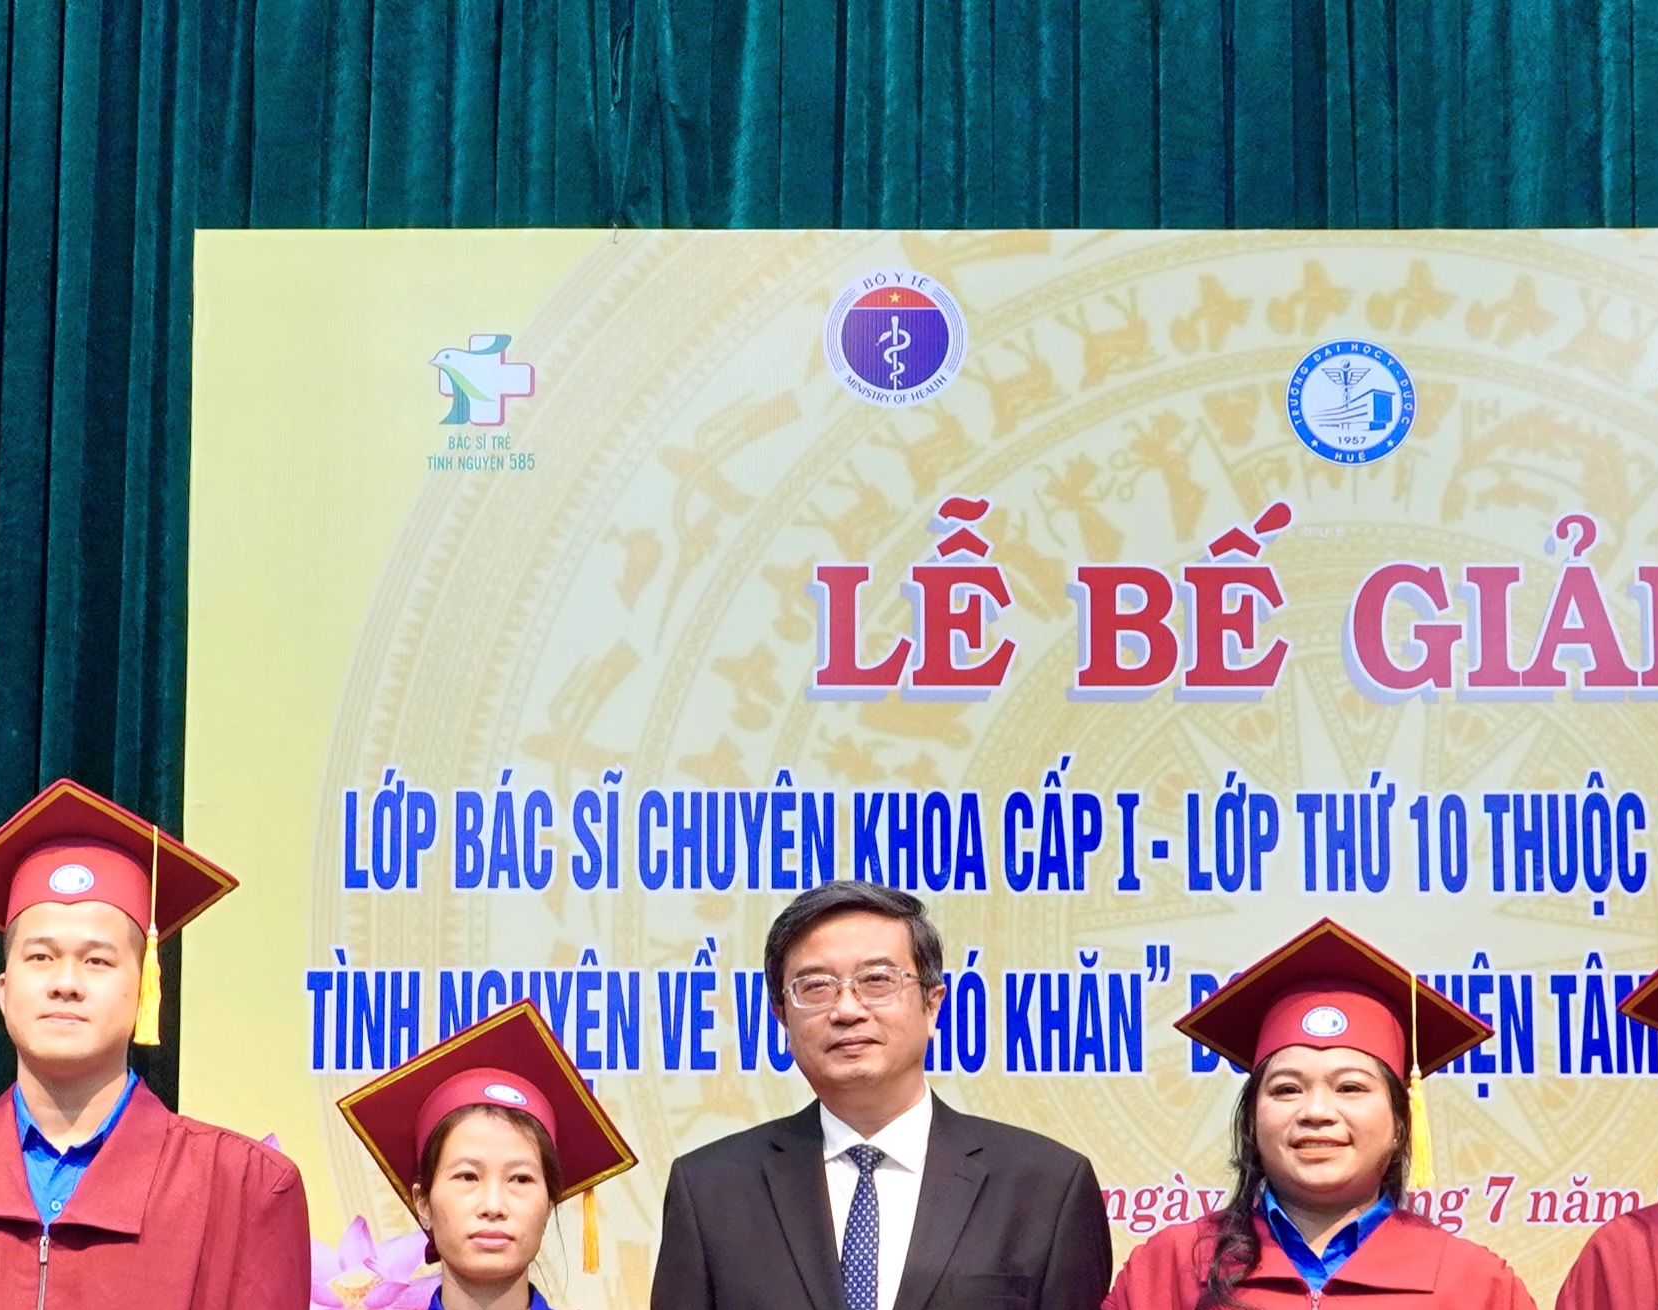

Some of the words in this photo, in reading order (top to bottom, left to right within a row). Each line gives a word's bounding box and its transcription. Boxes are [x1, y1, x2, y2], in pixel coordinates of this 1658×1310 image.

[894, 272, 904, 284] Y
[845, 375, 891, 403] MINISTRY
[894, 394, 908, 404] OF
[911, 374, 948, 401] HEALTH
[1338, 436, 1367, 445] 1957
[509, 453, 535, 470] 585
[820, 500, 1013, 685] LỄ
[1080, 505, 1289, 685] BẾ
[345, 770, 435, 889] LỚP
[456, 770, 552, 889] BÁC
[573, 772, 621, 889] SĨ
[639, 771, 834, 890] CHUYÊN
[855, 792, 986, 891] KHOA
[1005, 756, 1102, 891] CẤP
[1117, 793, 1142, 892] I
[1153, 841, 1168, 858] -
[1188, 772, 1278, 892] LỚP
[1297, 772, 1395, 892] THỨ
[1411, 795, 1467, 892] 10
[1484, 772, 1646, 915] THUỘC
[308, 950, 419, 1069] TÌNH
[659, 938, 715, 1070] VỀ
[1486, 1175, 1515, 1223] 7
[1526, 1175, 1641, 1223] năm
